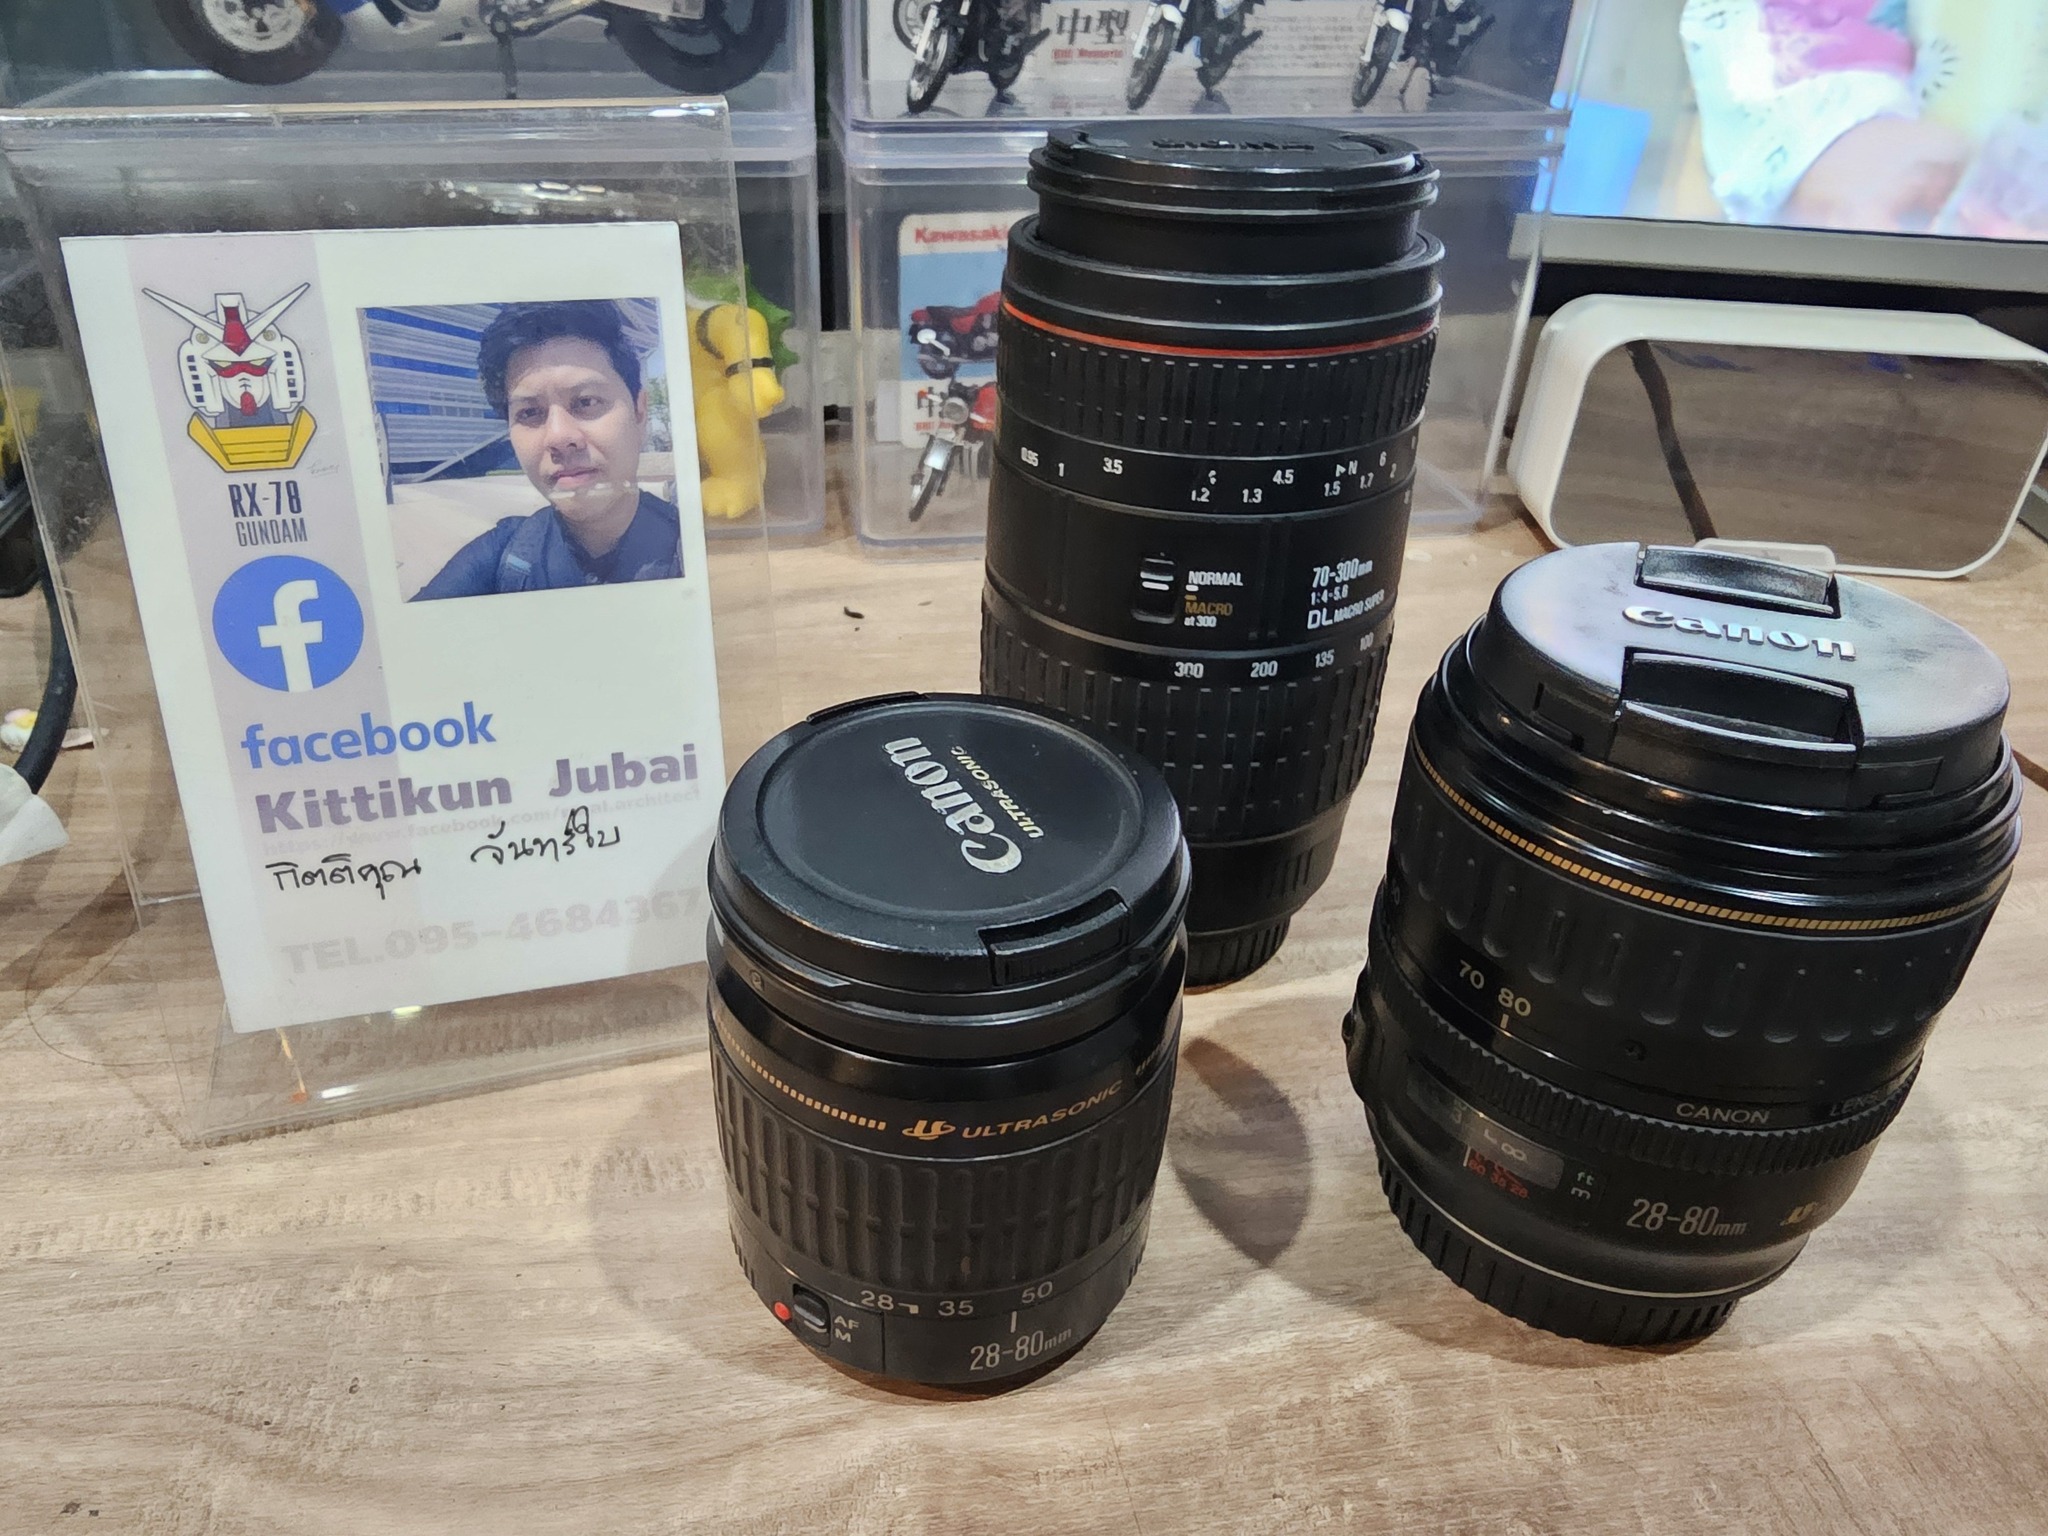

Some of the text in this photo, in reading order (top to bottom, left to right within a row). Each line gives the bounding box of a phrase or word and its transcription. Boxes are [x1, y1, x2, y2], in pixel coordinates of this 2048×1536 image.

[1242, 488, 1262, 503] 1.3
[1324, 480, 1341, 497] 1.5
[1272, 469, 1295, 485] 4.5
[228, 480, 302, 518] RX-78
[235, 517, 308, 547] GUNDAM
[1188, 571, 1244, 586] NORMAL
[1312, 558, 1373, 589] 70-300mm
[1185, 601, 1233, 616] MACRO
[1196, 615, 1217, 628] 300
[1307, 607, 1334, 630] DL
[1622, 605, 1857, 662] Canon
[1174, 662, 1204, 678] 300
[1250, 661, 1278, 678] 200
[1315, 649, 1335, 668] 135
[241, 701, 497, 769] facebook
[255, 743, 699, 834] Kittikun Jubai
[951, 746, 1045, 838] ULTRASONIC
[884, 737, 1022, 873] Canon
[1459, 959, 1532, 1017] 70 80
[962, 1079, 1123, 1139] ULTRASONIC
[1676, 1103, 1770, 1124] CANON
[1626, 1198, 1748, 1236] 28-80mm
[860, 1281, 1054, 1317] 28 35 50
[833, 1316, 860, 1331] AF
[834, 1329, 852, 1343] M
[969, 1328, 1072, 1372] 28-80mm
